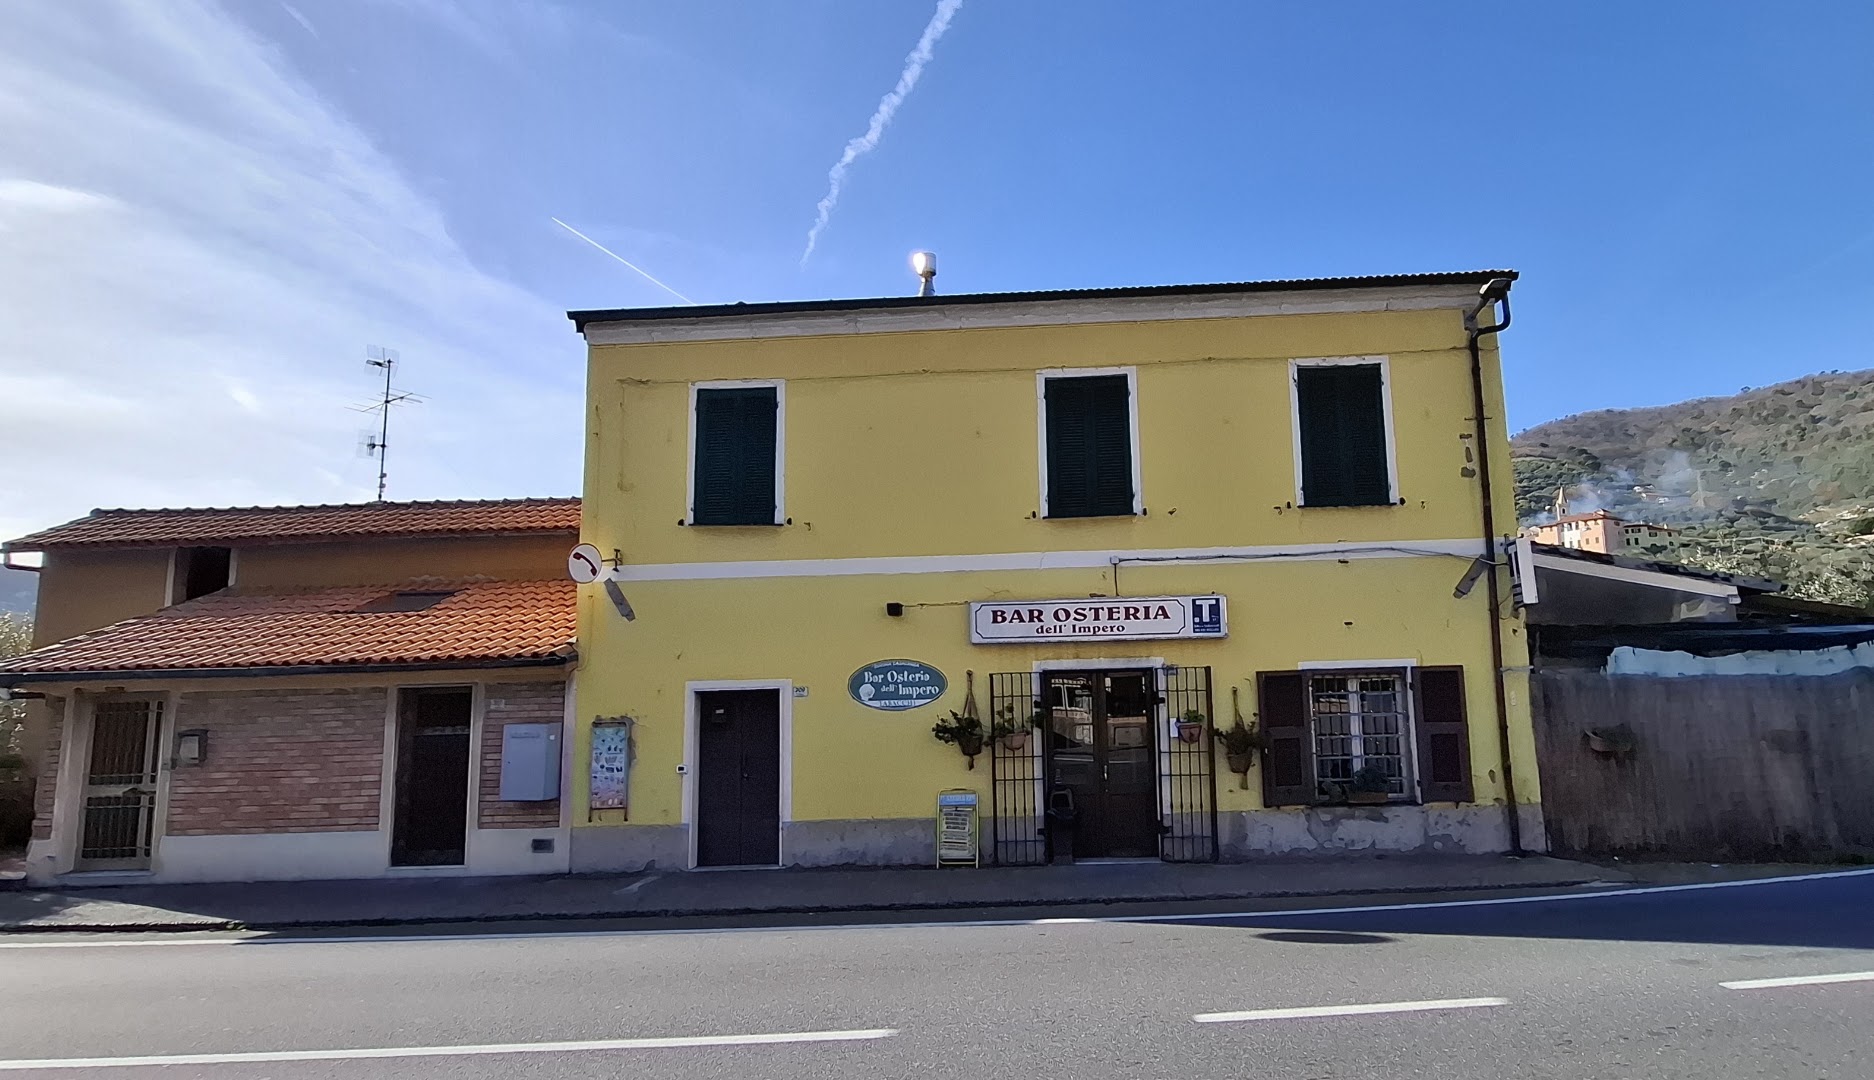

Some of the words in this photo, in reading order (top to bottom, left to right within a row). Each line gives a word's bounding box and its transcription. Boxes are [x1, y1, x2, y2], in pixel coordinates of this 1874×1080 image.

[991, 608, 1044, 624] BAR
[1053, 605, 1171, 622] OSTERIA
[1035, 624, 1067, 634] dell'
[1072, 623, 1126, 635] Impero
[864, 671, 884, 683] Bar
[887, 670, 930, 682] Osteria
[899, 684, 939, 699] Impero
